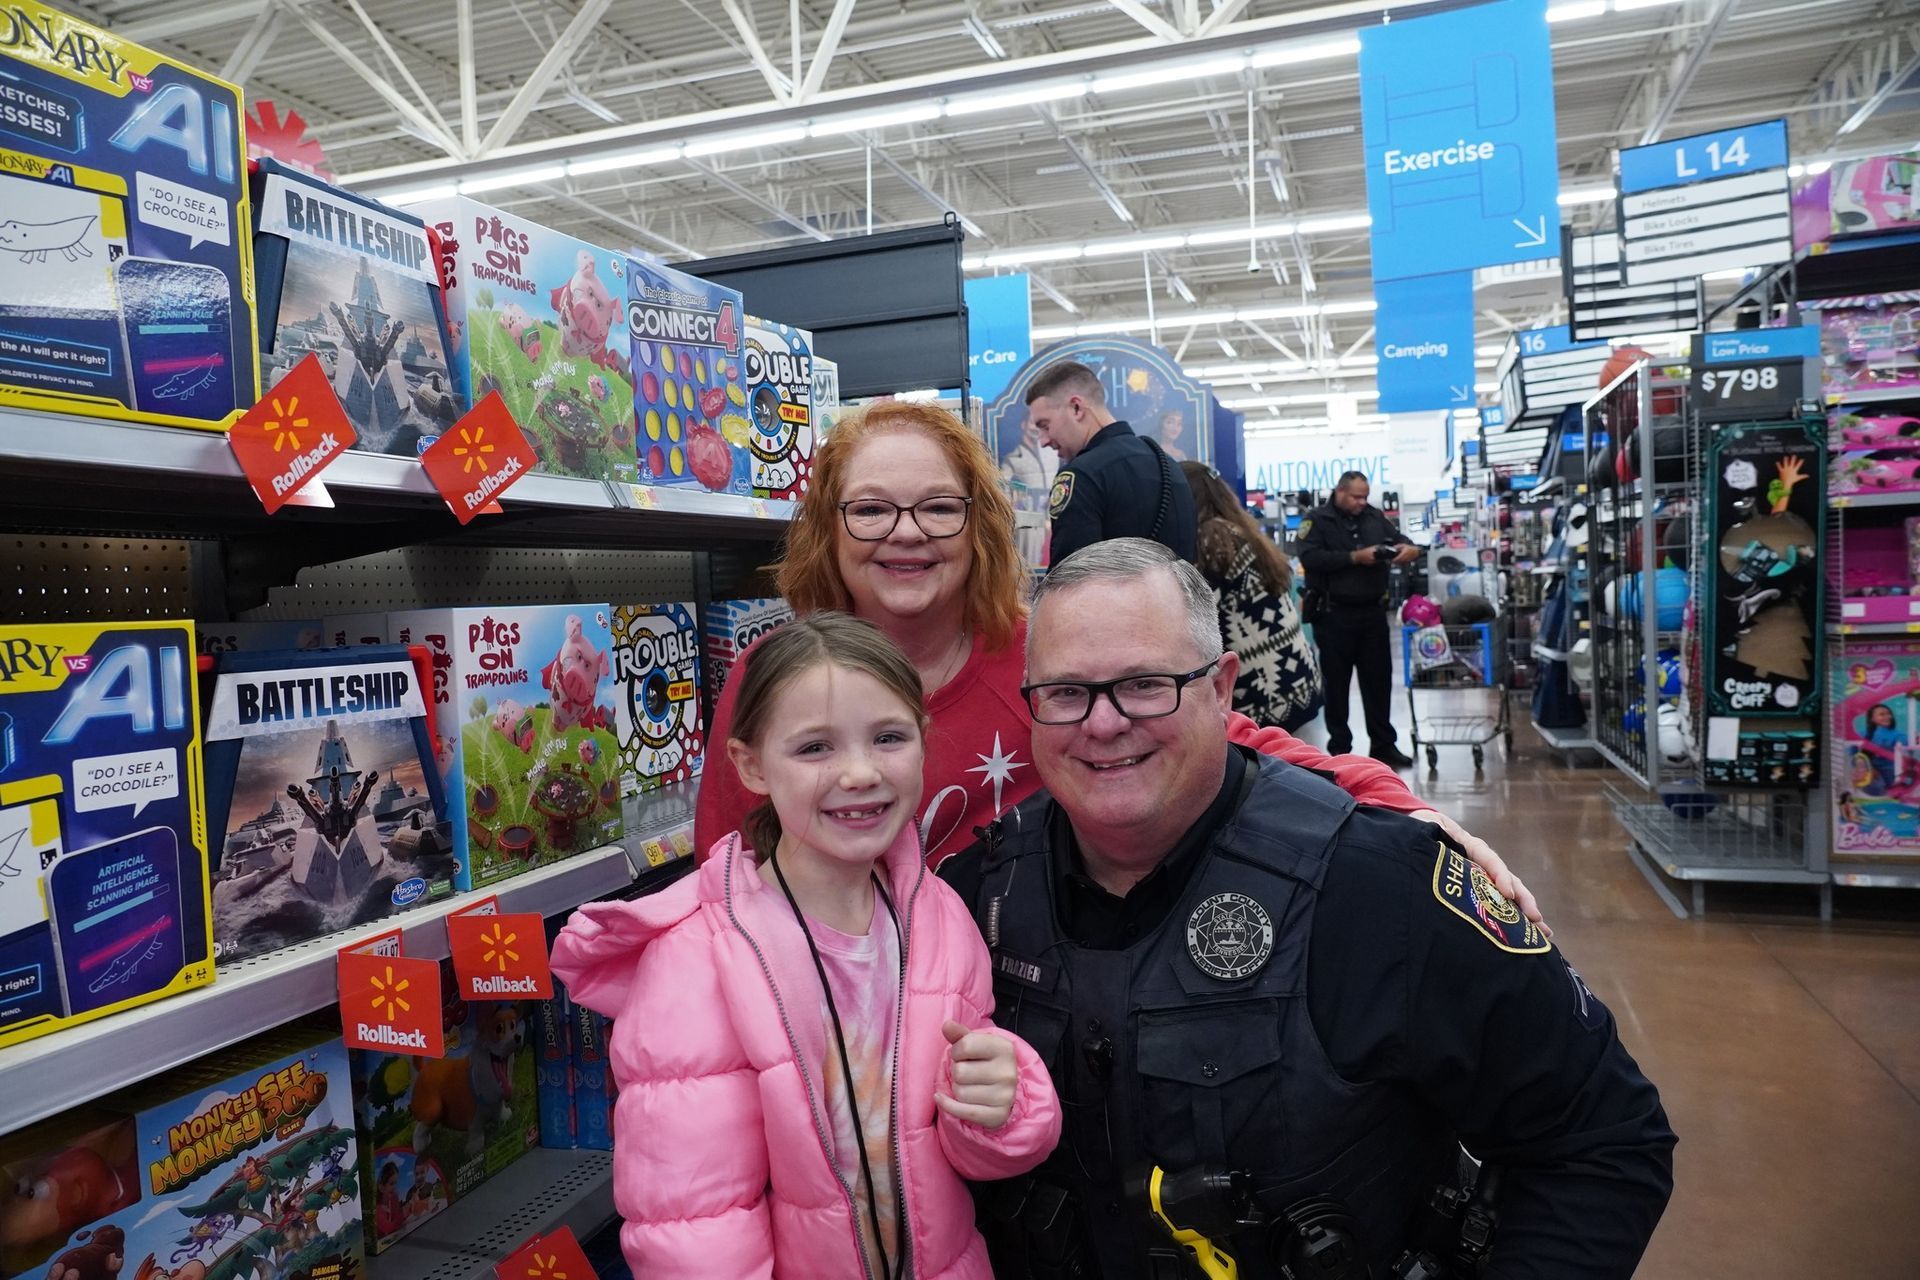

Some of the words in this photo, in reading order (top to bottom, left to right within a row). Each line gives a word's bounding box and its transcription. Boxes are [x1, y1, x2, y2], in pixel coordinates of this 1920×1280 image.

[109, 84, 235, 183] AI
[1384, 139, 1495, 175] Exercise
[1675, 148, 1698, 177] L
[1705, 136, 1749, 171] 14
[184, 197, 206, 214] SEE
[207, 204, 217, 215] A
[1642, 194, 1686, 209] Helmets
[285, 189, 428, 270] BATTLESHIP
[1644, 221, 1665, 231] Bike
[1669, 215, 1699, 228] Locks
[1644, 244, 1666, 254] Bike
[1669, 239, 1694, 250] Tires
[486, 250, 521, 275] ON
[472, 262, 537, 295] TRAMPOLINES
[629, 308, 716, 342] CONNECT
[716, 302, 738, 352] 4
[1, 341, 17, 351] the
[20, 344, 31, 353] AI
[33, 347, 50, 356] will
[52, 351, 69, 360] get
[71, 352, 78, 361] it
[79, 355, 106, 365] right?
[1384, 342, 1448, 359] Camping
[1523, 334, 1546, 352] 16
[1712, 347, 1736, 357] Low
[1739, 344, 1769, 354] Price
[983, 349, 1016, 364] Care
[790, 383, 809, 395] GAME
[782, 406, 794, 418] TRY
[272, 431, 340, 497] Rollback
[463, 456, 523, 510] Rollback
[68, 658, 88, 670] VS
[479, 648, 513, 670] ON
[613, 630, 695, 684] TROUBLE
[677, 658, 693, 671] GAME
[465, 669, 528, 689] TRAMPOLINES
[41, 645, 184, 744] AI
[236, 671, 409, 725] BATTLESHIP
[670, 686, 680, 697] TRY
[128, 762, 151, 775] SEE
[155, 761, 164, 771] A
[526, 758, 546, 781] Make
[555, 737, 568, 752] fly
[1838, 823, 1896, 848] Barbie
[98, 854, 146, 878] ARTIFICIAL
[92, 864, 154, 895] INTELLIGENCE
[87, 886, 133, 911] SCANNING
[135, 874, 160, 891] IMAGE
[1190, 894, 1225, 930] BLOUNT
[1230, 894, 1271, 928] COUNTY
[1001, 956, 1042, 984] FRAZIER
[1239, 942, 1271, 974] OFFICE
[5, 975, 36, 993] right?
[472, 976, 538, 993] Rollback
[357, 1024, 427, 1048] Rollback
[543, 1000, 556, 1048] ONNECT
[168, 1087, 257, 1154] MONKEY
[256, 1060, 308, 1100] SEE
[150, 1110, 264, 1196] MONKEY
[263, 1072, 328, 1131] POO
[282, 1121, 302, 1136] GAME
